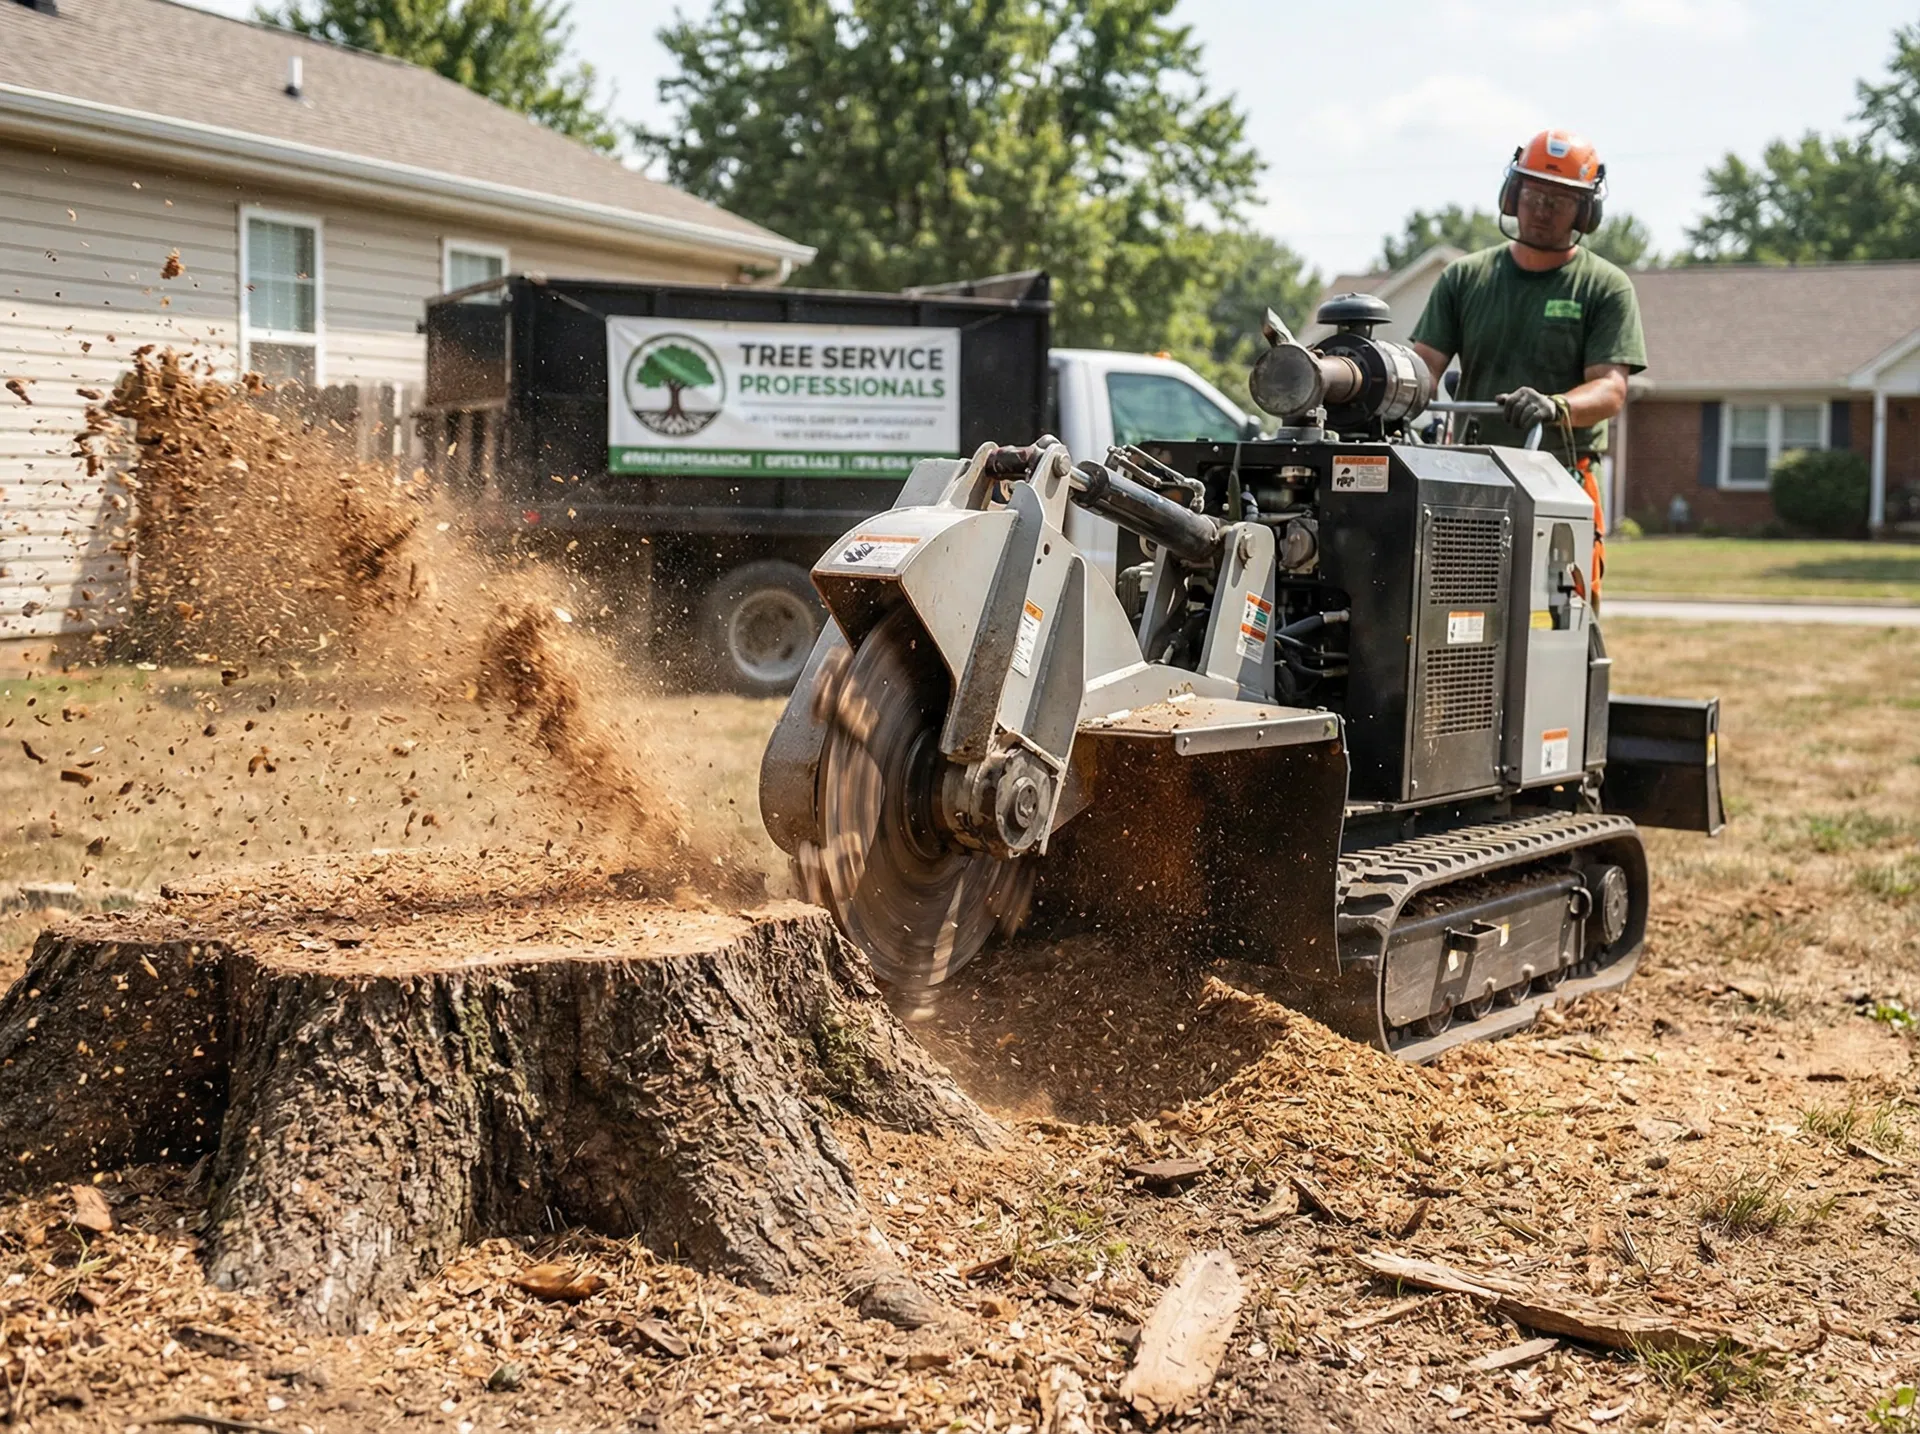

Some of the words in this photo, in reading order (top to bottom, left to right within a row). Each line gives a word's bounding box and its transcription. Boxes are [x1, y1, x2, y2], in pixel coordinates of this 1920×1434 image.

[739, 344, 814, 368] TREE
[821, 346, 944, 370] SERVICE
[739, 374, 946, 398] PROFESSIONALS
